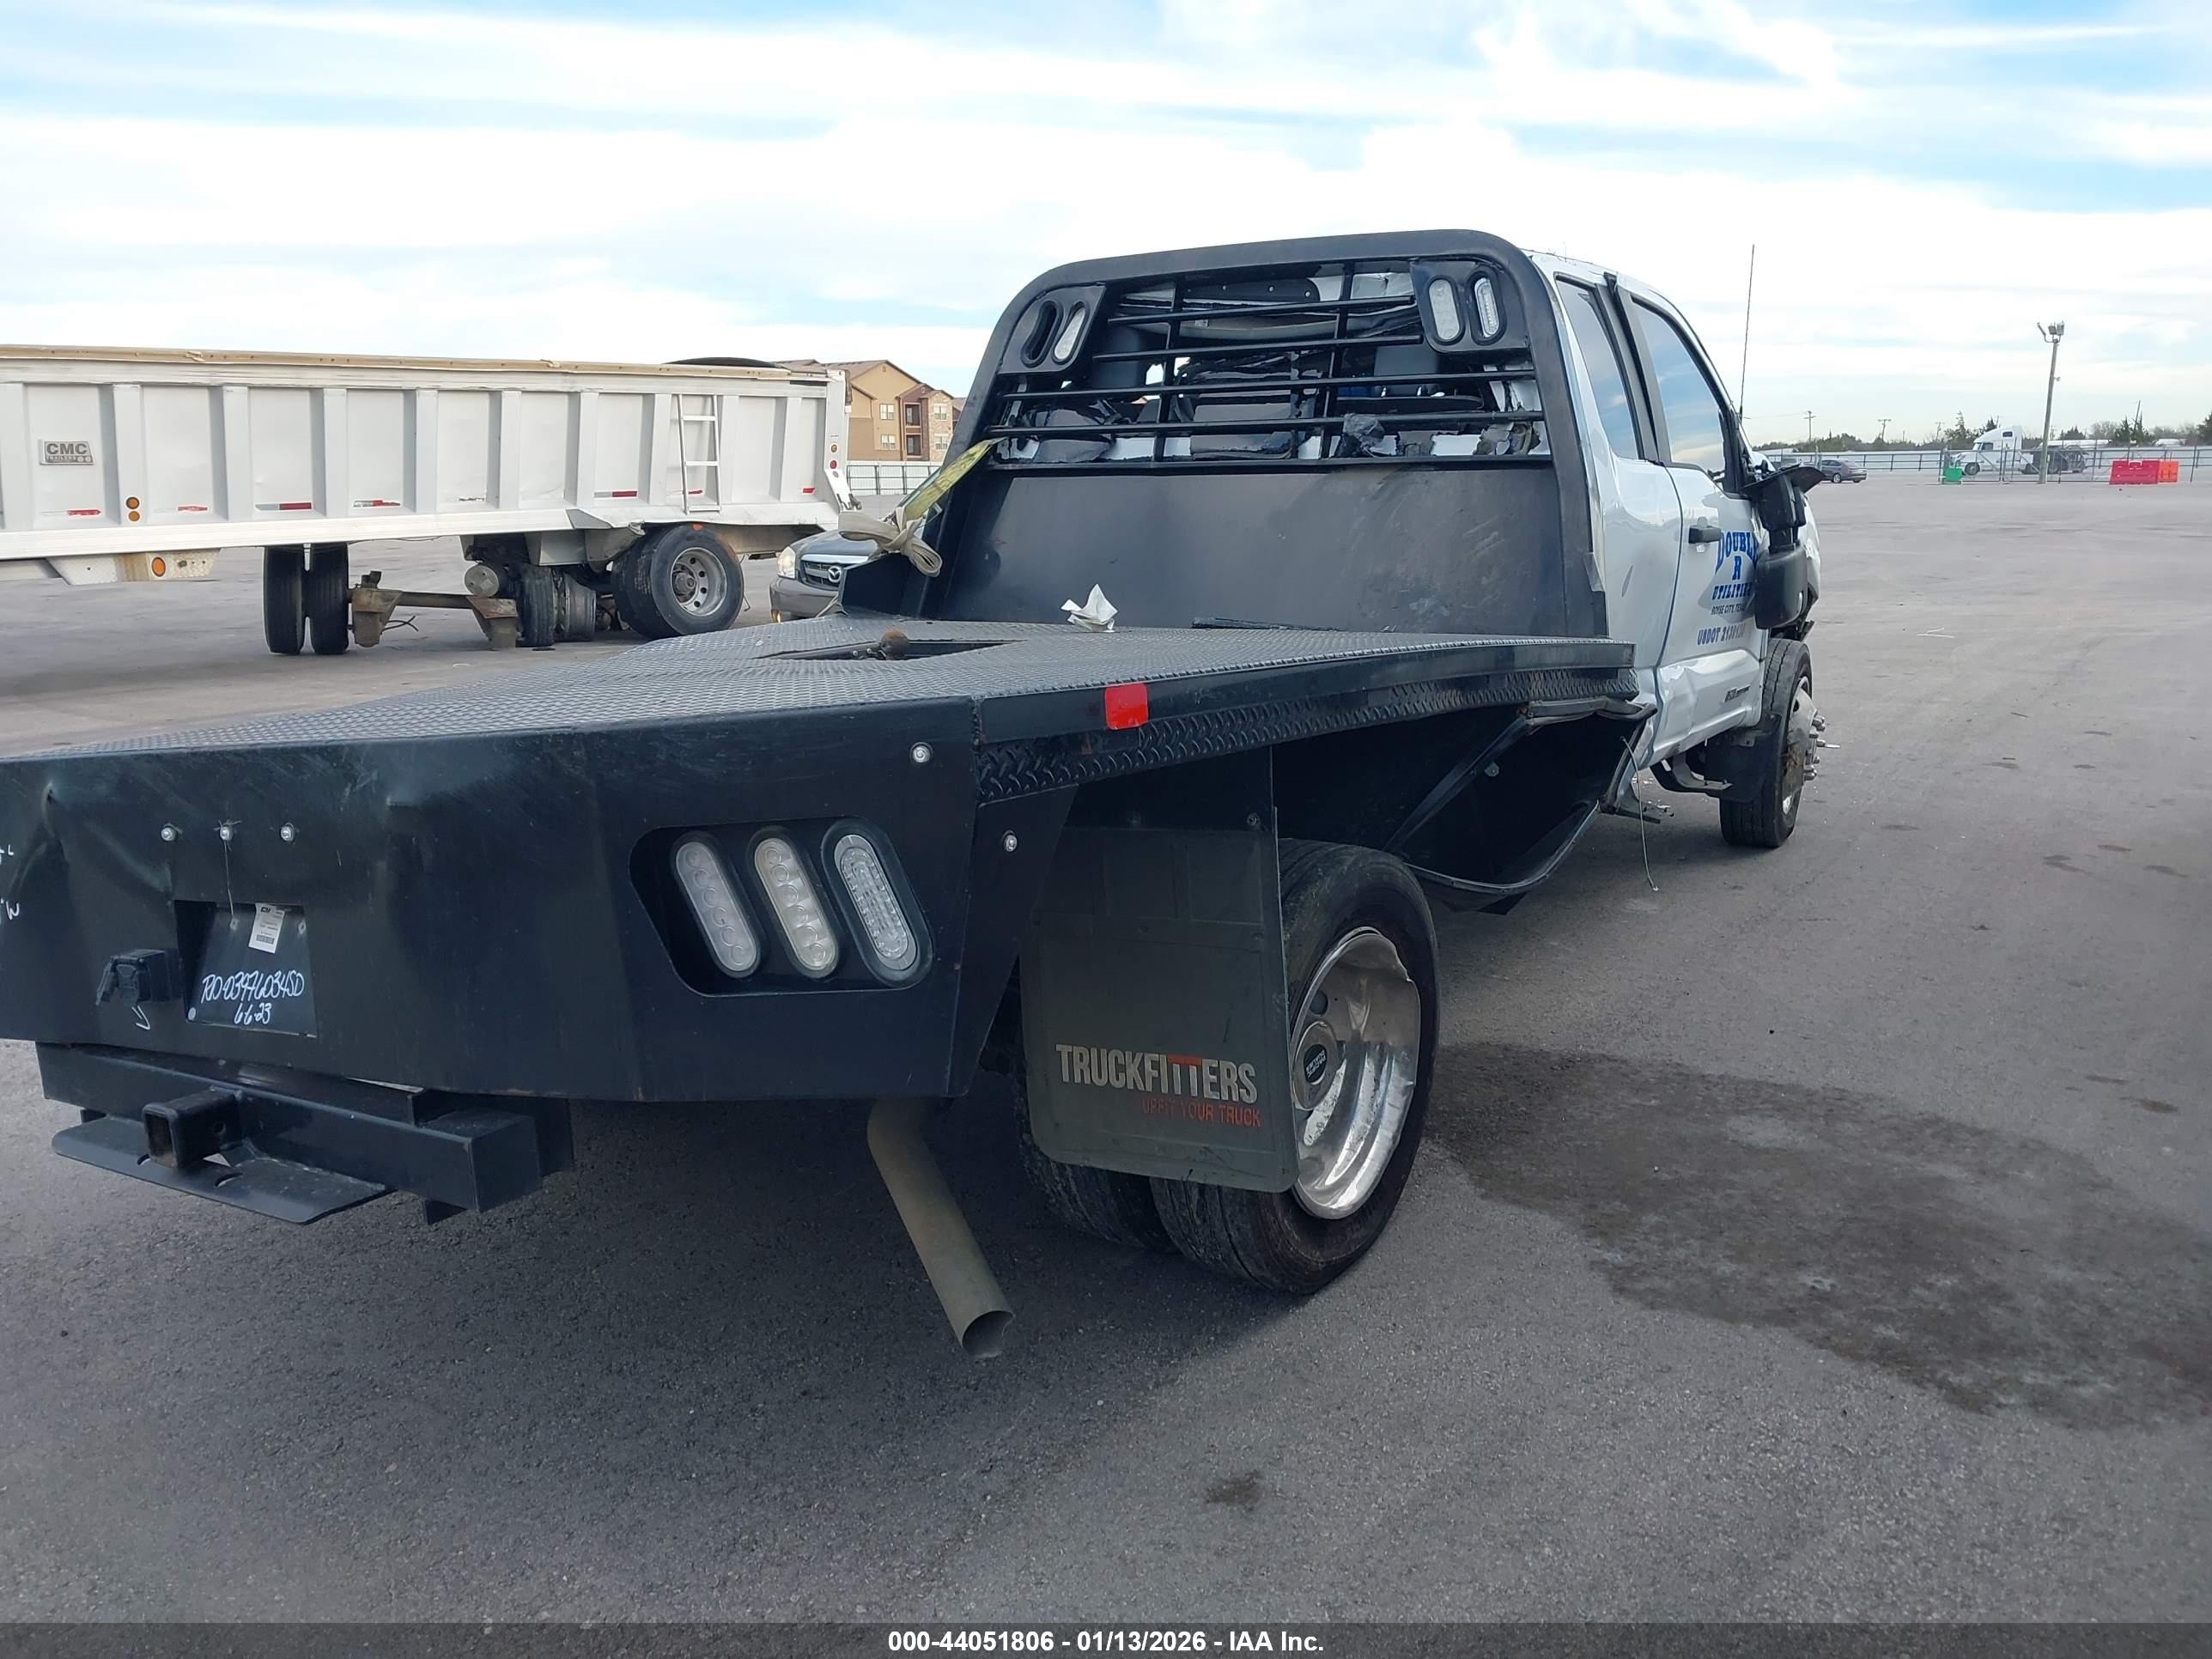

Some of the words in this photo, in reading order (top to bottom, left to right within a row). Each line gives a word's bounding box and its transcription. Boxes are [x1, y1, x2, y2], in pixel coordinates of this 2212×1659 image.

[46, 443, 88, 455] CMC
[1732, 555, 1742, 580] R
[1697, 627, 1721, 646] USDOT
[1055, 1043, 1258, 1104] TRUCKFITTERS
[1181, 1099, 1214, 1123] YOUR
[1218, 1103, 1261, 1127] TRUCK
